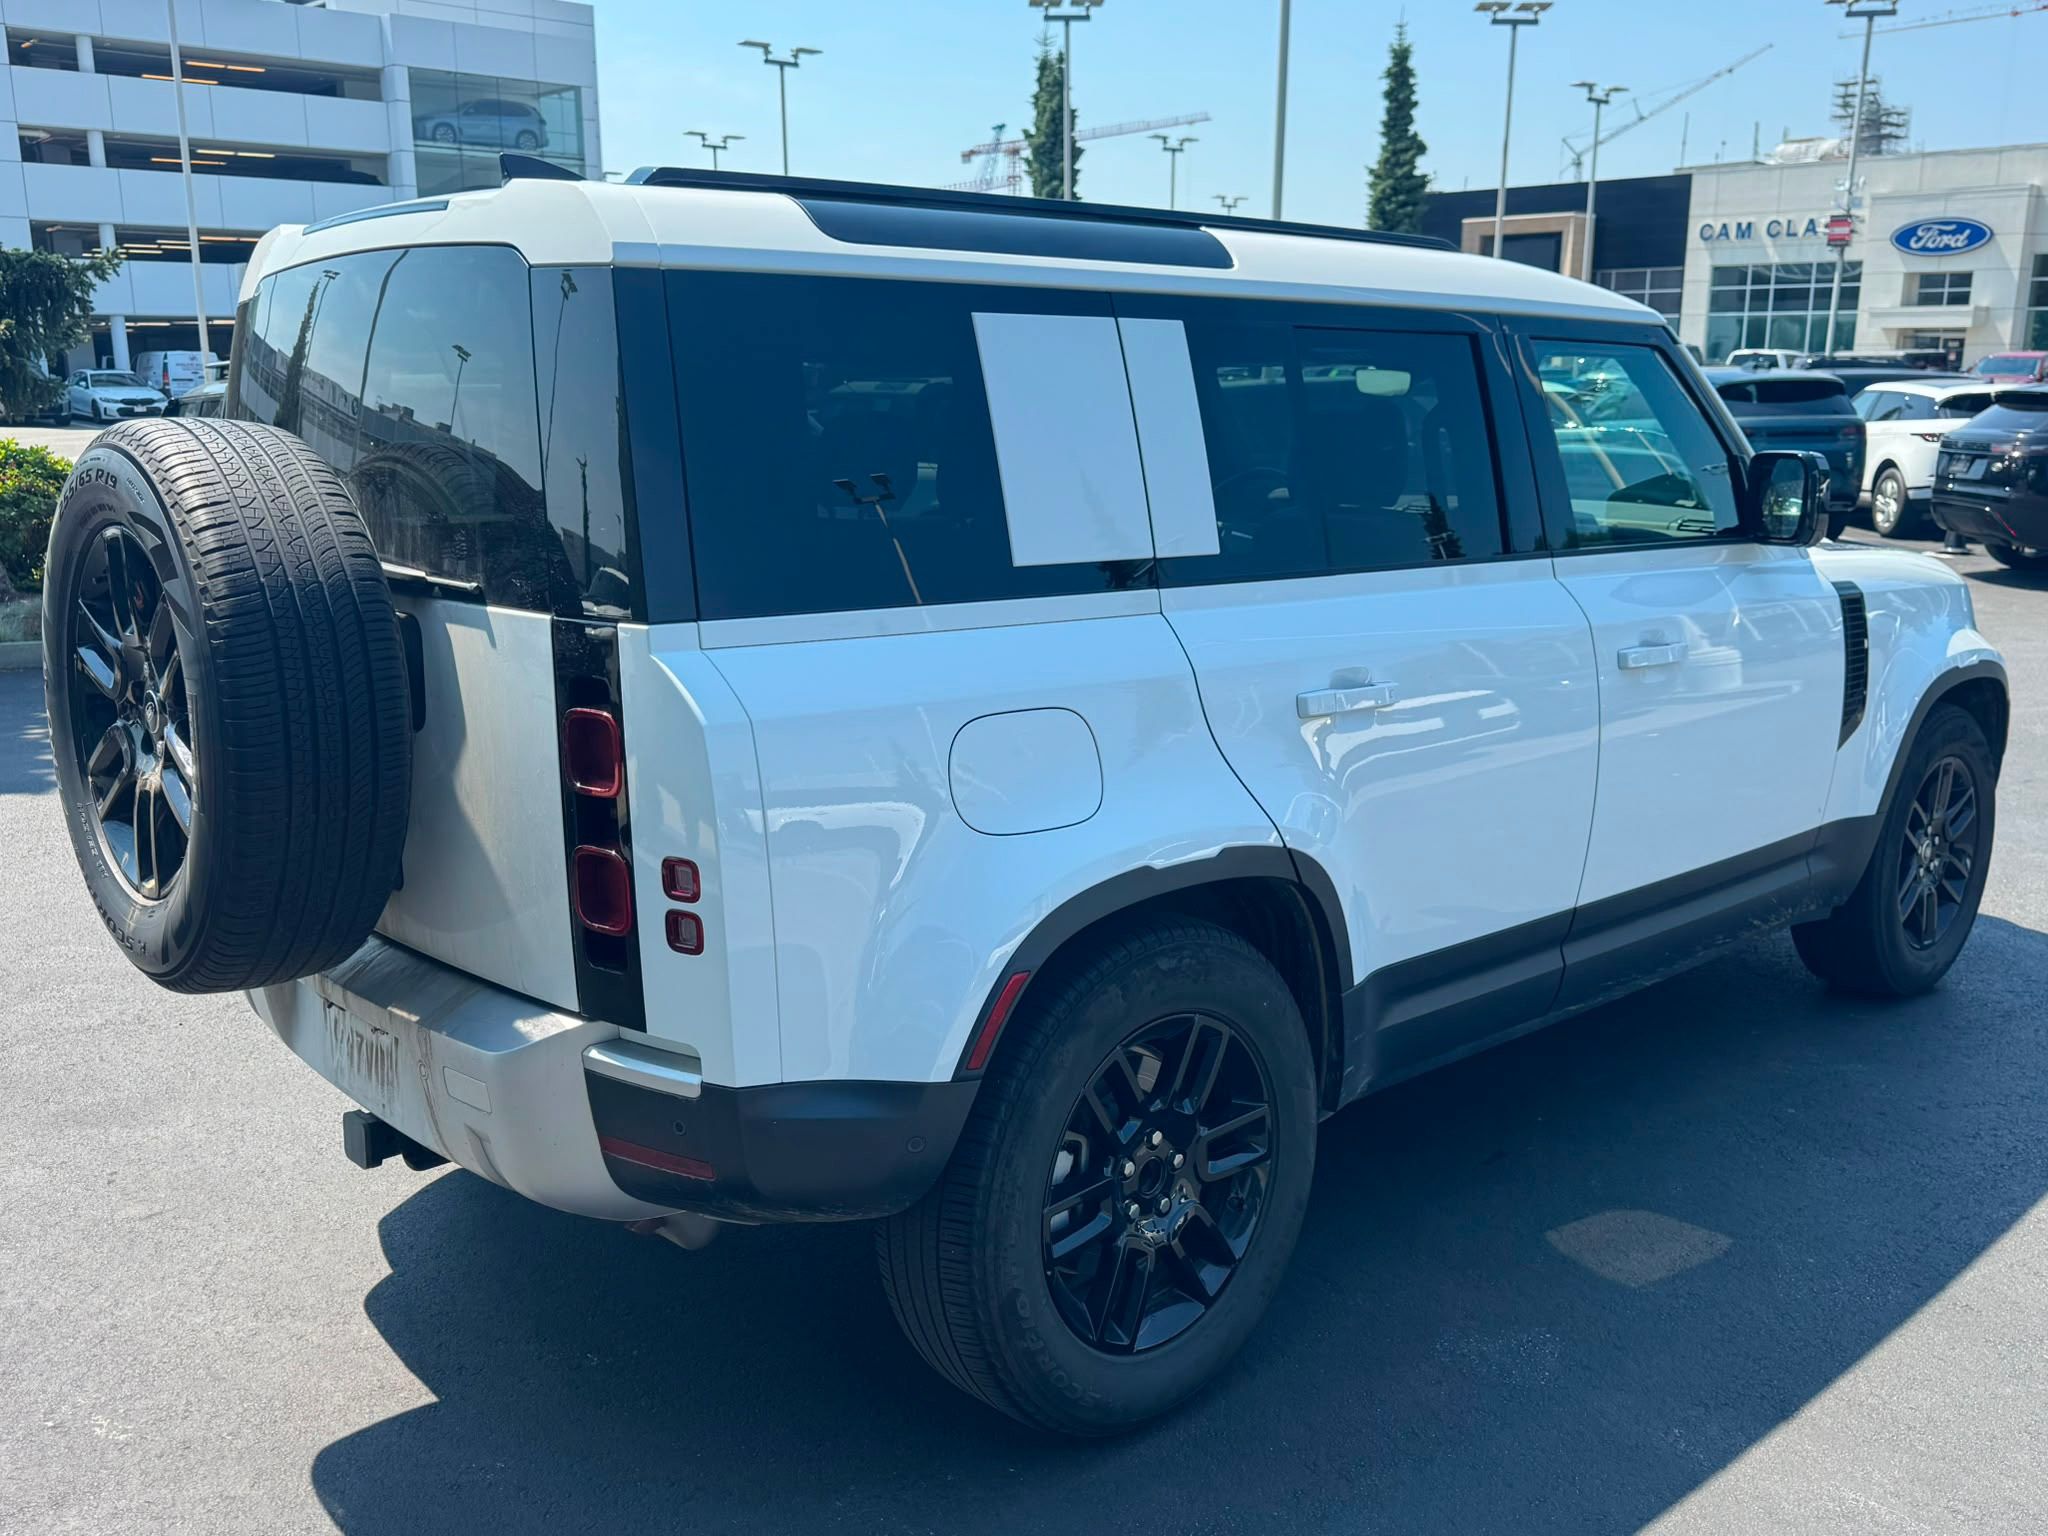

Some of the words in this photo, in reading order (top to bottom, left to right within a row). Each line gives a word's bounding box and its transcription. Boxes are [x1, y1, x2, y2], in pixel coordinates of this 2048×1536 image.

[1700, 222, 1752, 241] CAM
[1766, 218, 1818, 238] CLA
[1909, 223, 1972, 250] Ford
